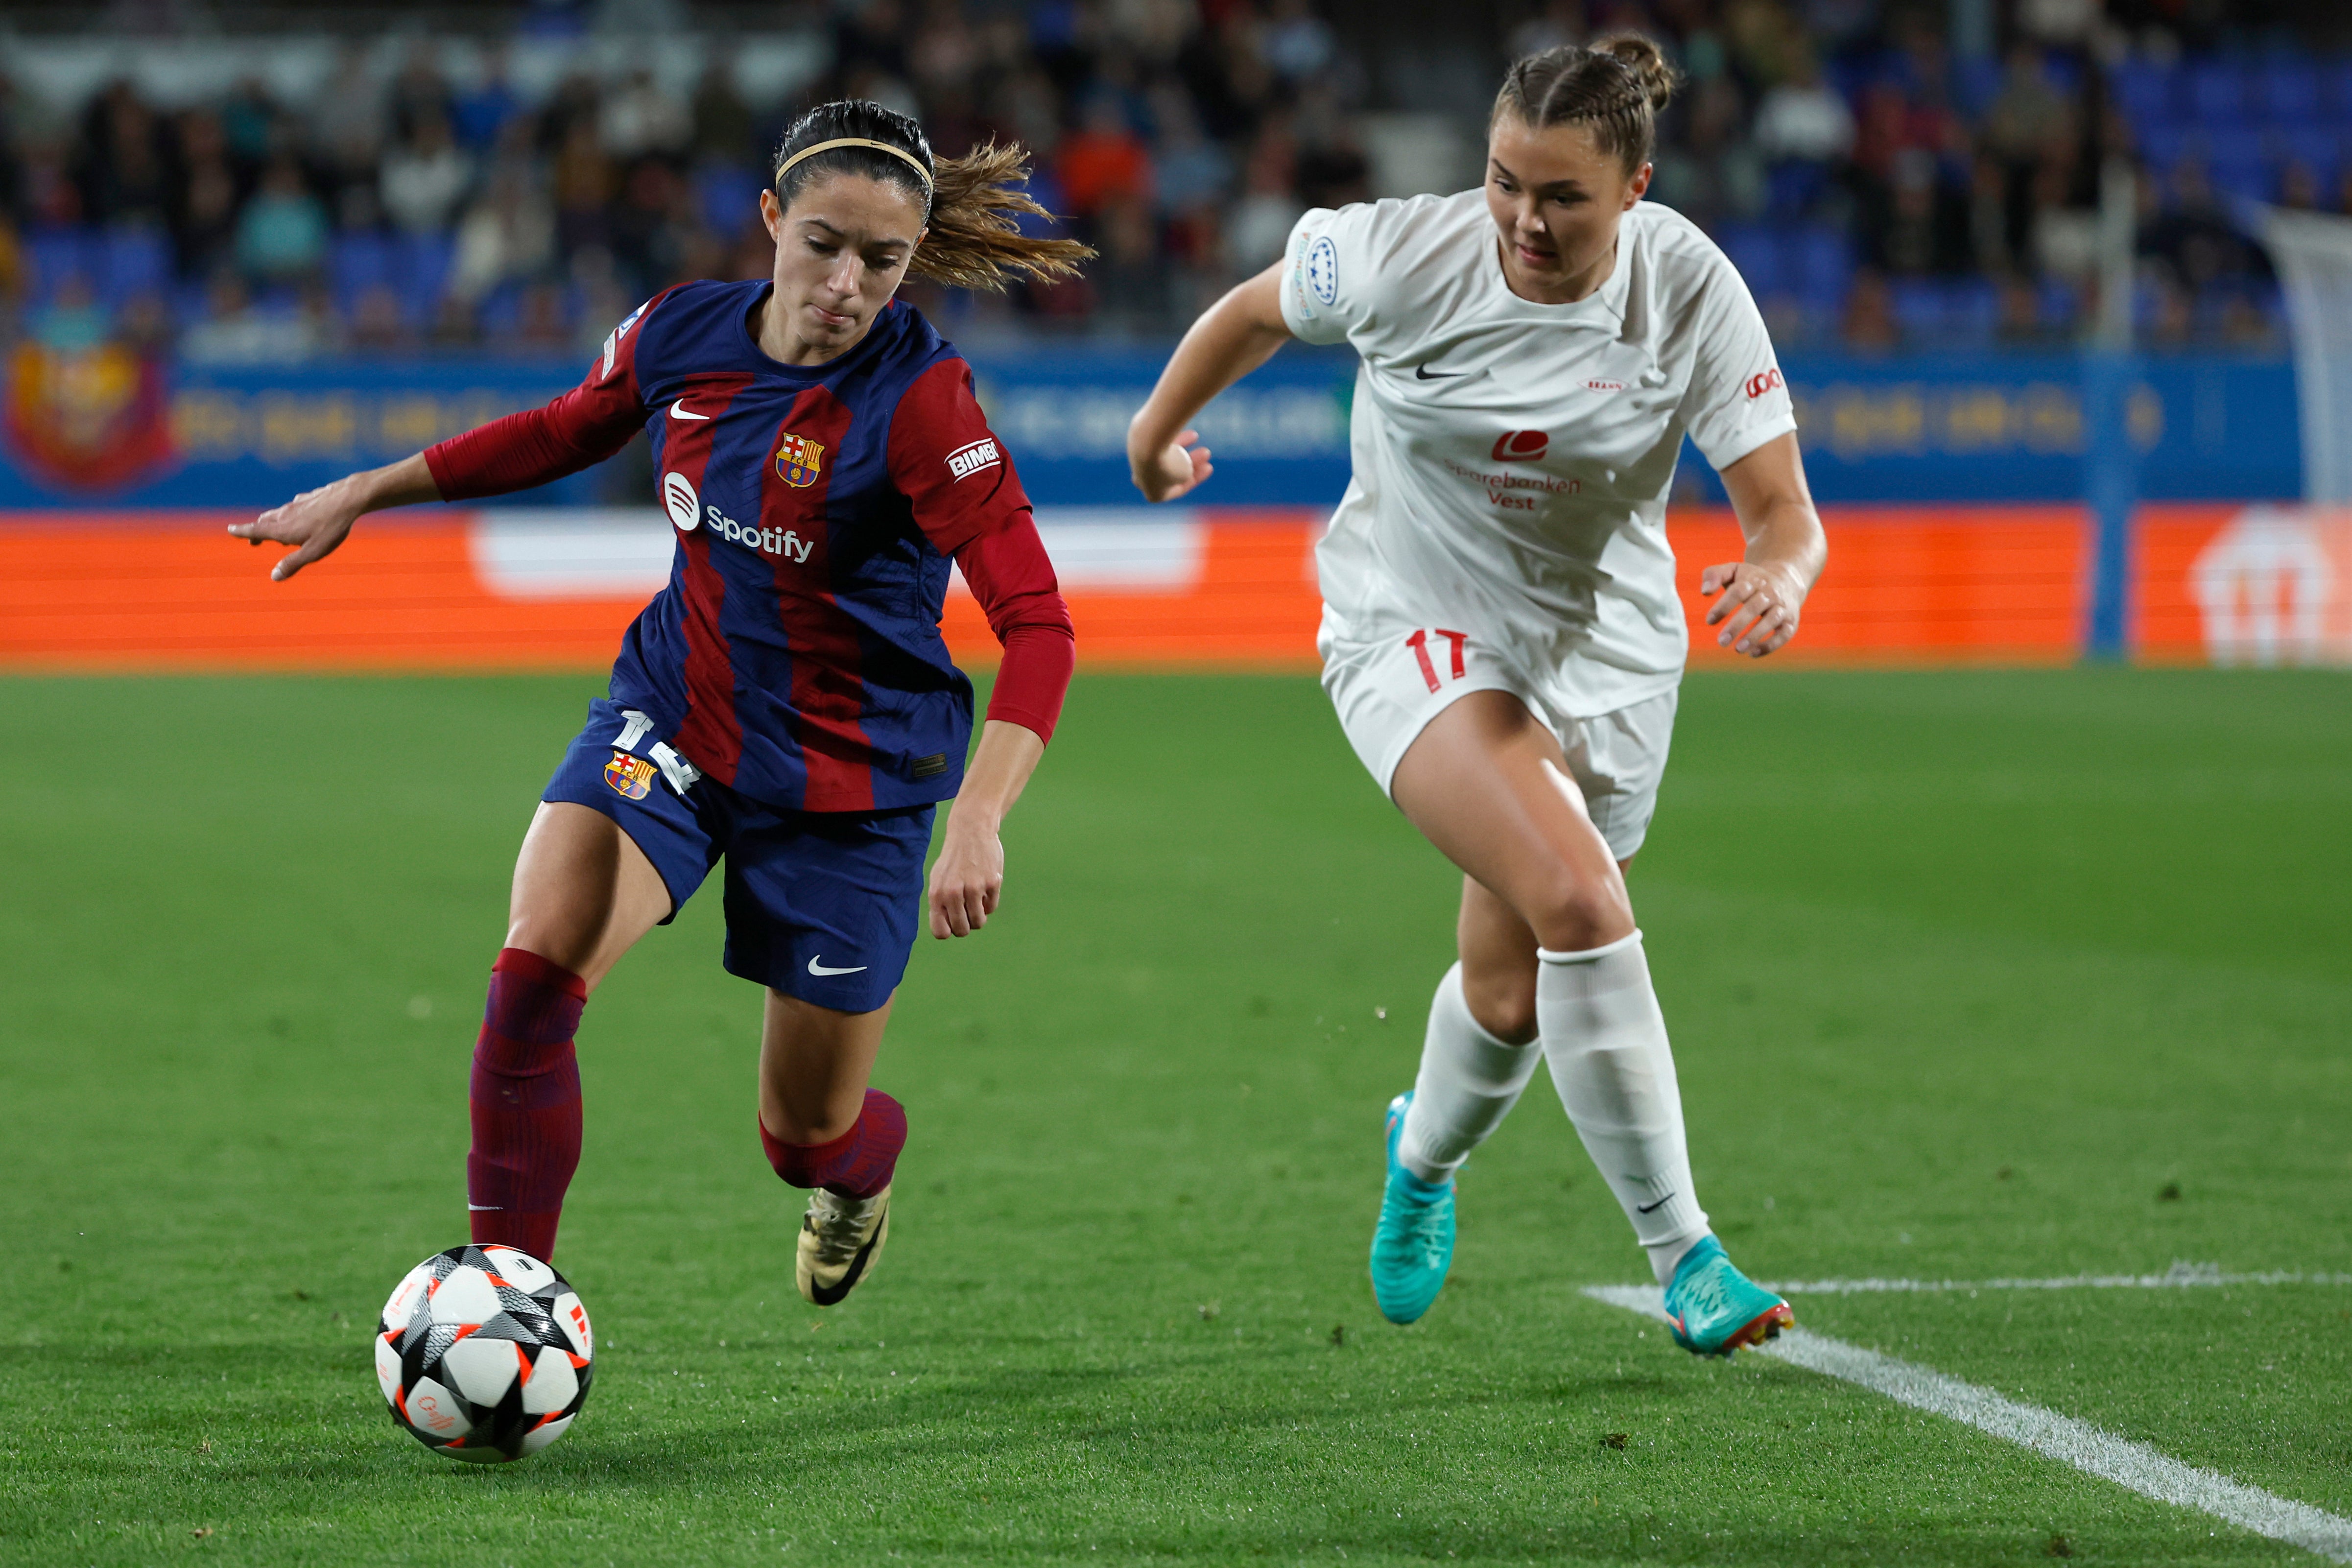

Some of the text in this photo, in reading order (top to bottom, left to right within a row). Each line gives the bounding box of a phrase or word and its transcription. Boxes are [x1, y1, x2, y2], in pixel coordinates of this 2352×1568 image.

[790, 455, 808, 467] FCB
[1487, 489, 1535, 511] Vest
[707, 505, 814, 563] Spotify
[1406, 628, 1468, 694] 17
[620, 769, 638, 781] FCB
